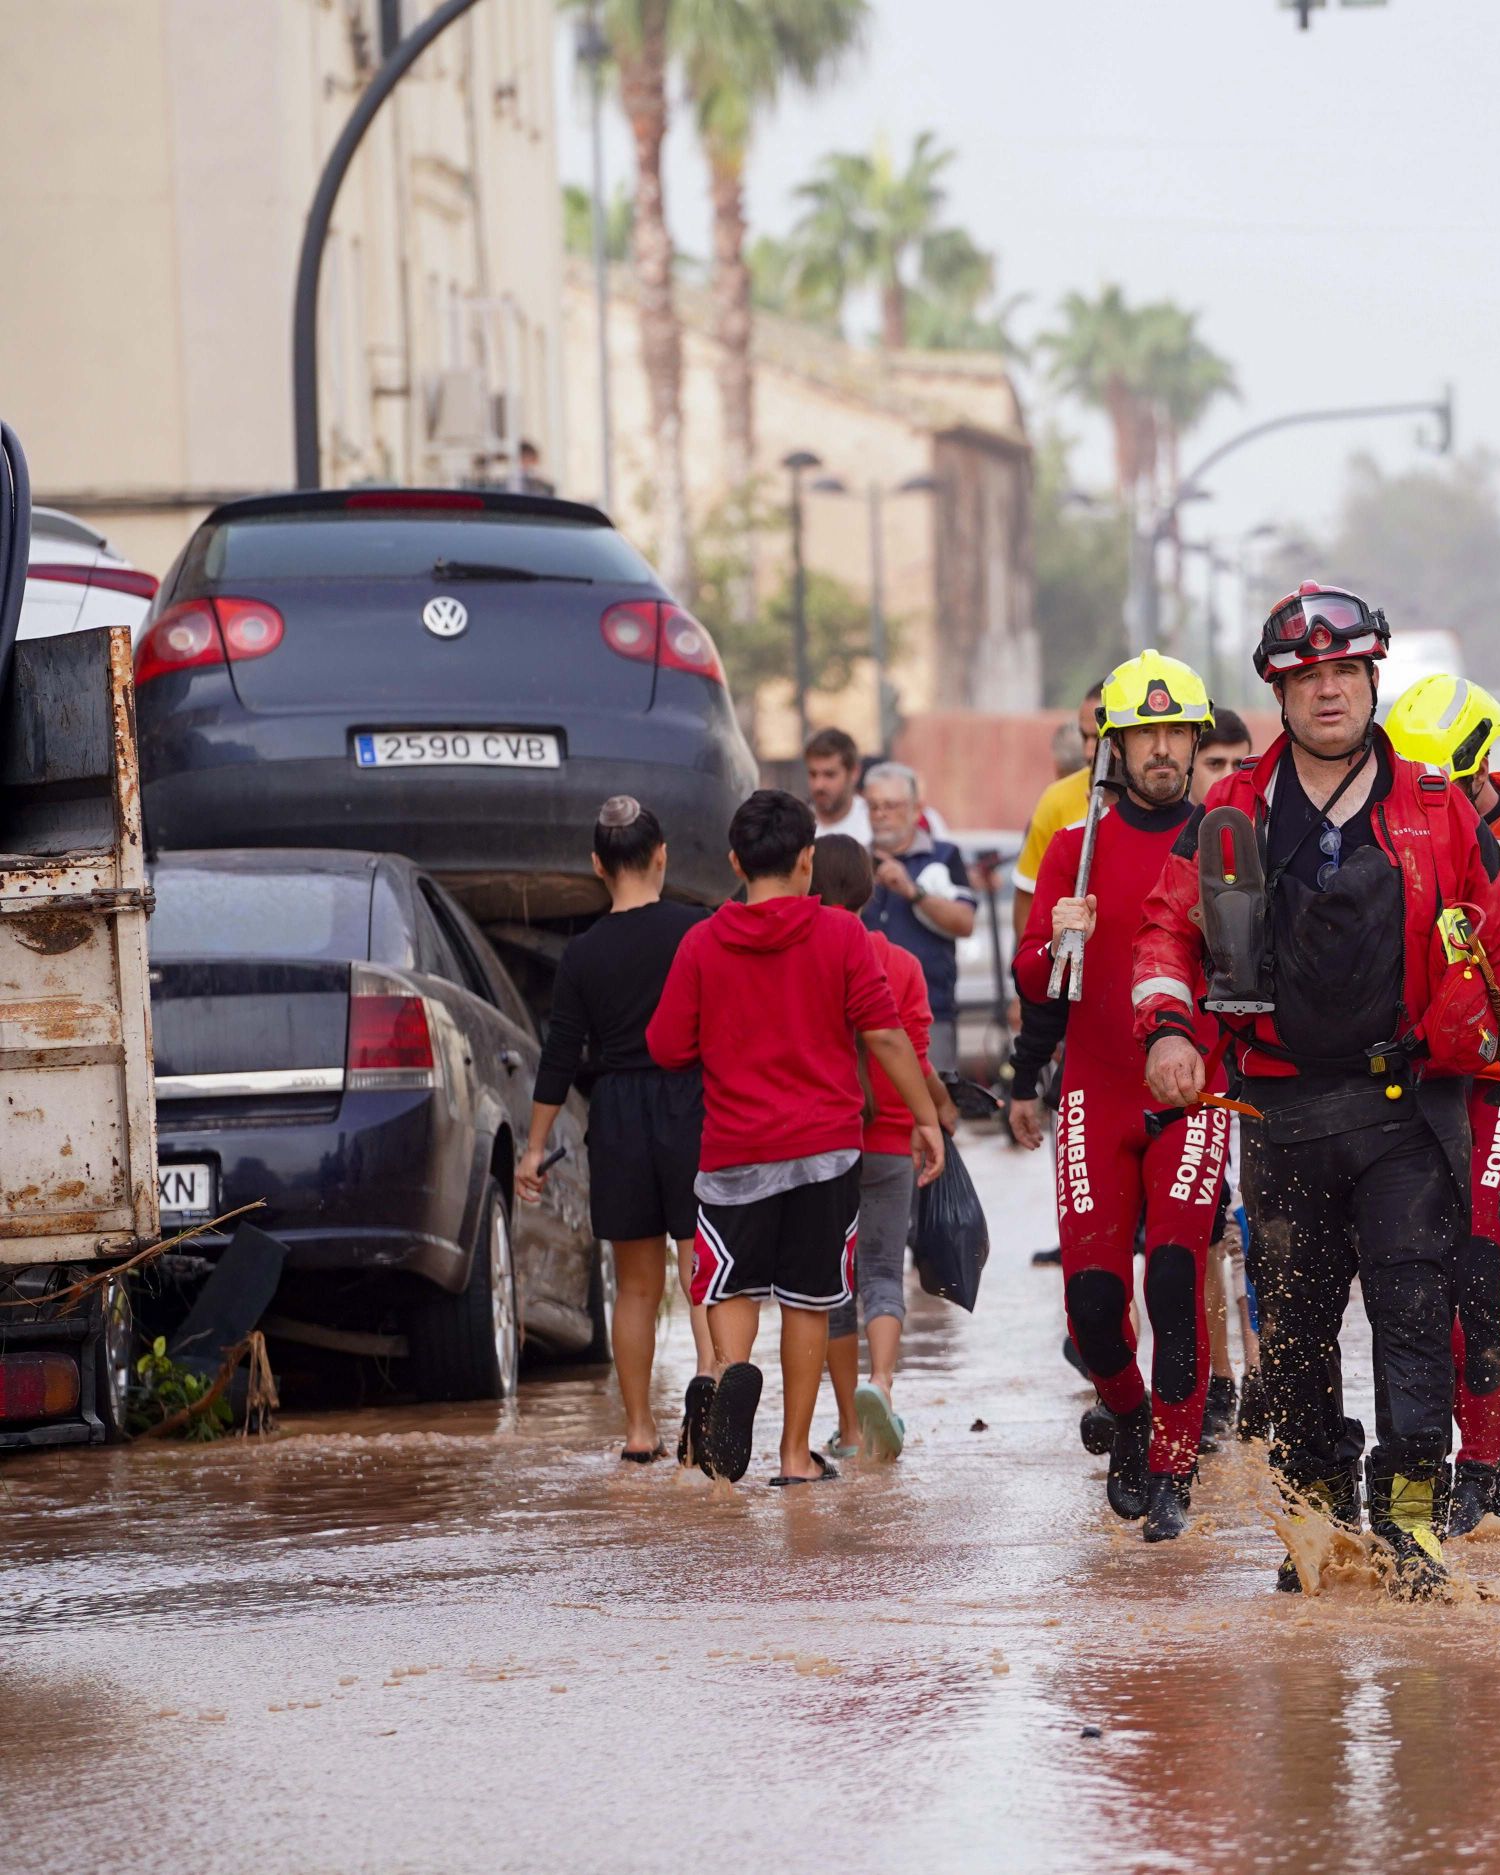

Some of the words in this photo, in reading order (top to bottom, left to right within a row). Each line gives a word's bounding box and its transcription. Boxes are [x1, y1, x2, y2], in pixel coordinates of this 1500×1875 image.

[384, 735, 470, 760] 2590
[482, 736, 546, 762] CVB
[1067, 1089, 1095, 1214] BOMBERS
[1169, 1101, 1208, 1201] BOMBE
[159, 1172, 196, 1203] XN
